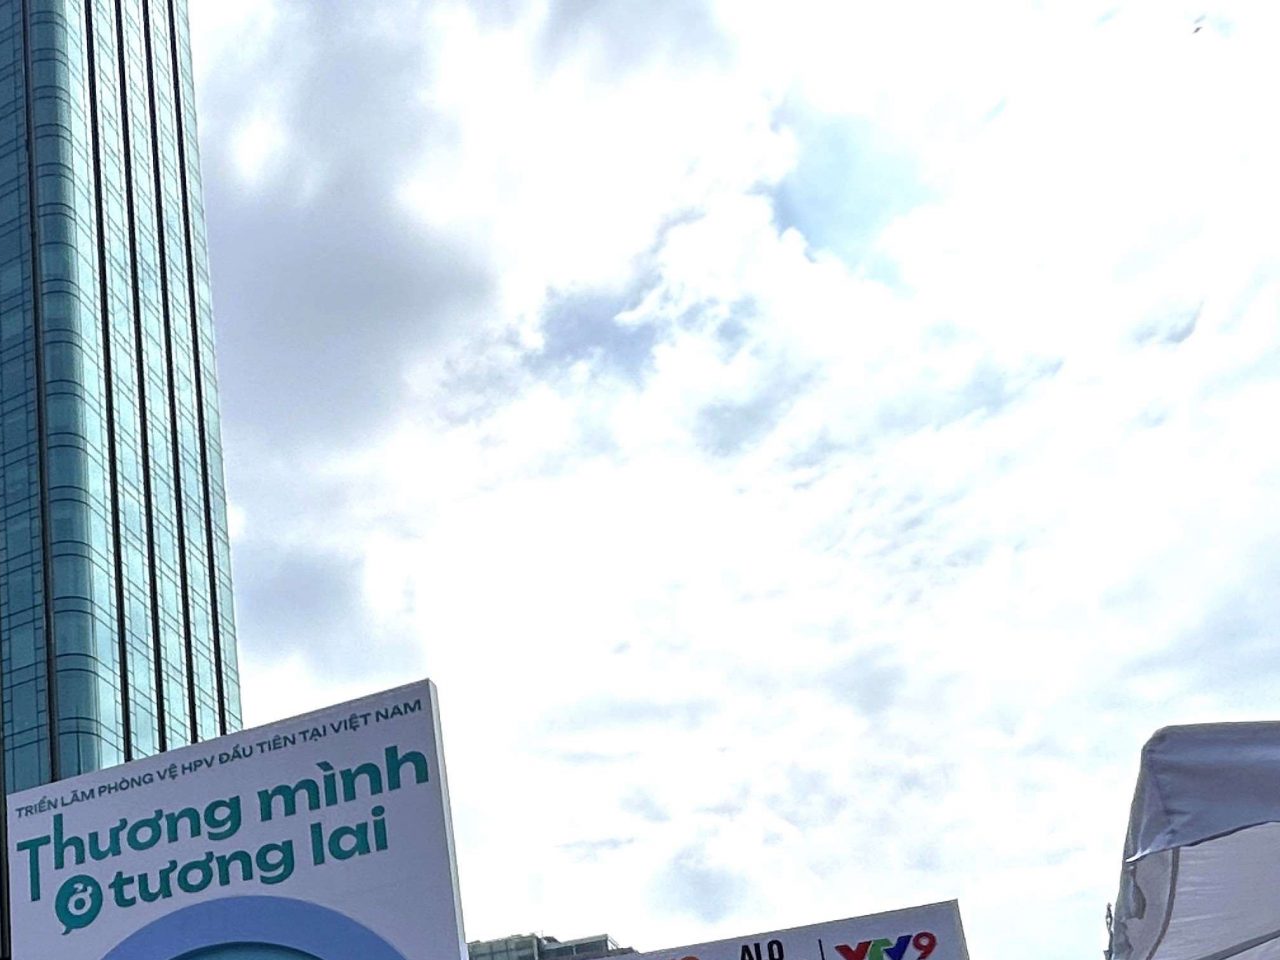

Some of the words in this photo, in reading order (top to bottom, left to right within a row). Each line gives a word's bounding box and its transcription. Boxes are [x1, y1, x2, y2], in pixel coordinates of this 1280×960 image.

[15, 796, 59, 820] TRIỂN
[60, 786, 96, 808] LÃM
[98, 772, 154, 797] PHÒNG
[156, 763, 179, 782] VỆ
[181, 755, 217, 777] HPV
[219, 743, 254, 767] ĐẦU
[258, 733, 296, 755] TIÊN
[298, 725, 327, 747] TẠI
[329, 710, 373, 738] VIỆT
[375, 699, 422, 722] NAM
[17, 793, 242, 902] Thương
[260, 744, 430, 823] mình
[107, 840, 295, 909] tương
[310, 805, 389, 867] lai
